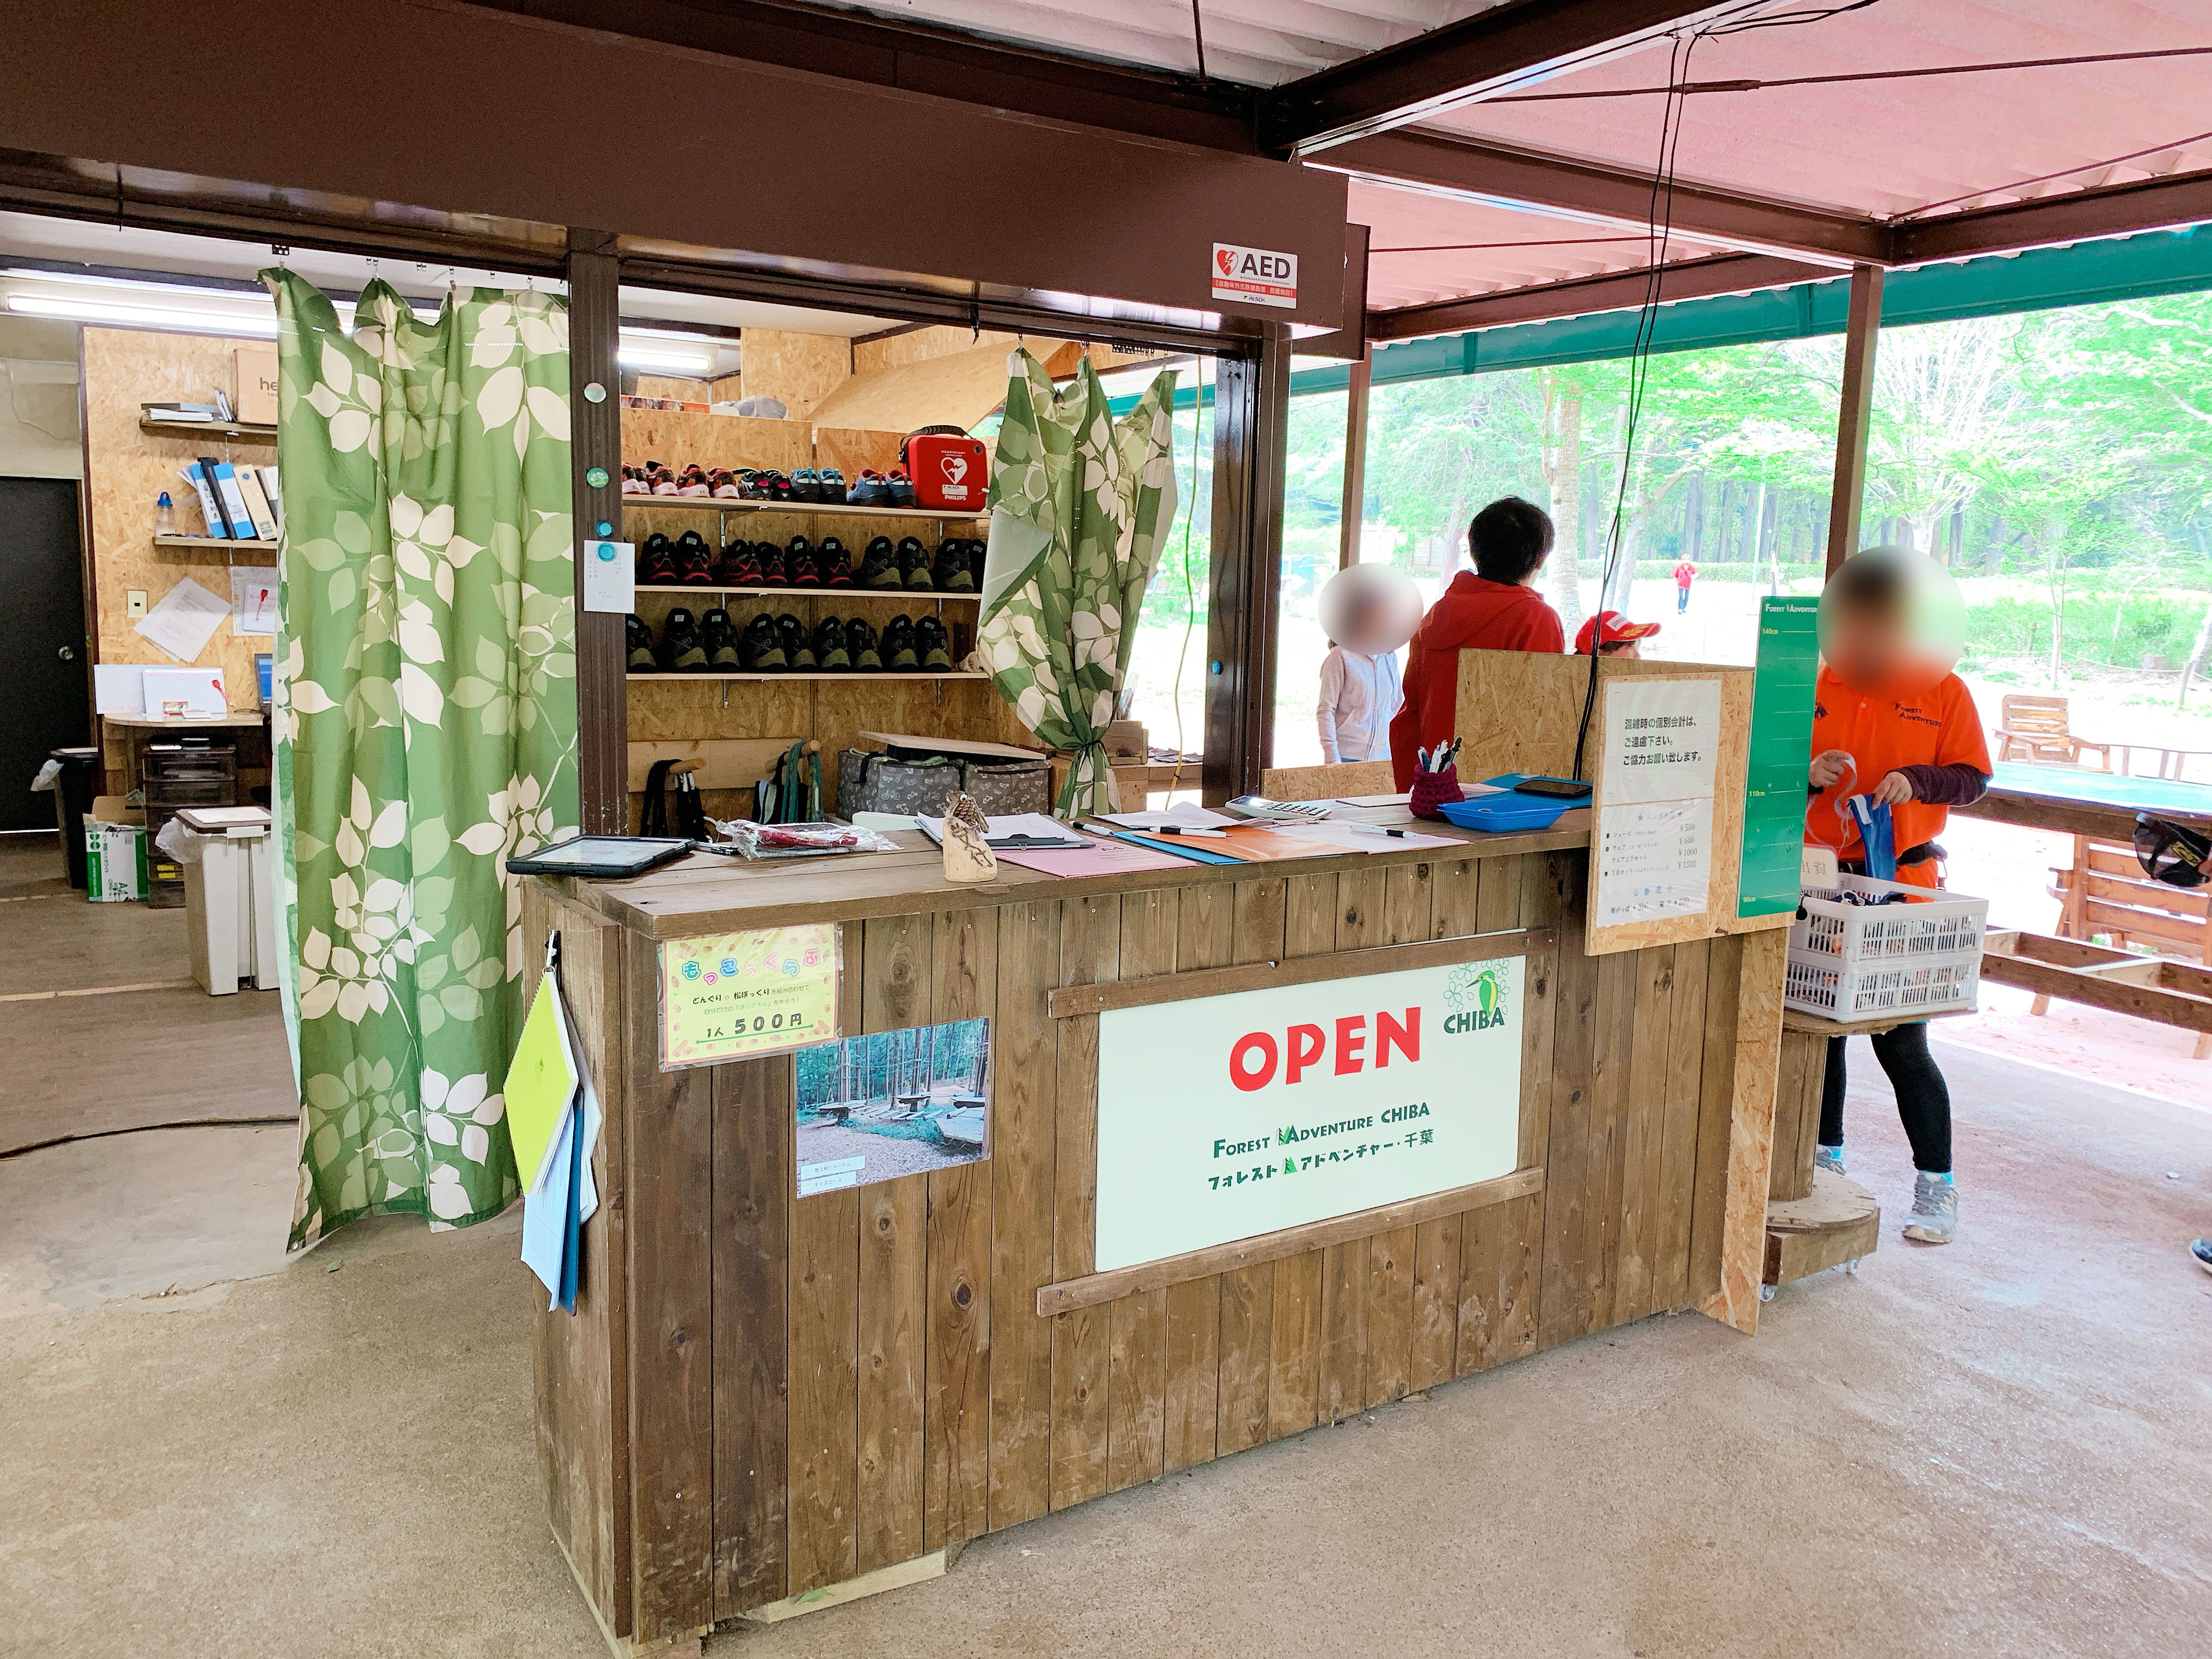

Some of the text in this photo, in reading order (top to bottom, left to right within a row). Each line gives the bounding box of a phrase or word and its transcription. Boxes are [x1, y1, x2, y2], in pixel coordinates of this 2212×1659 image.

[1240, 253, 1290, 279] AED
[1790, 604, 1817, 613] ADVENTUR
[1624, 716, 1697, 730] 混雑時の個別会計は、
[1624, 736, 1673, 747] ご遠慮下さい。
[1623, 751, 1701, 766] ご協力お願い致します。
[682, 948, 820, 985] もっこうくらぶ
[1443, 1007, 1505, 1034] CHIBA
[1229, 1006, 1421, 1092] OPEN
[1214, 1103, 1430, 1158] FOREST ADVENTURE CHIBA
[1208, 1165, 1278, 1190] フォレスト
